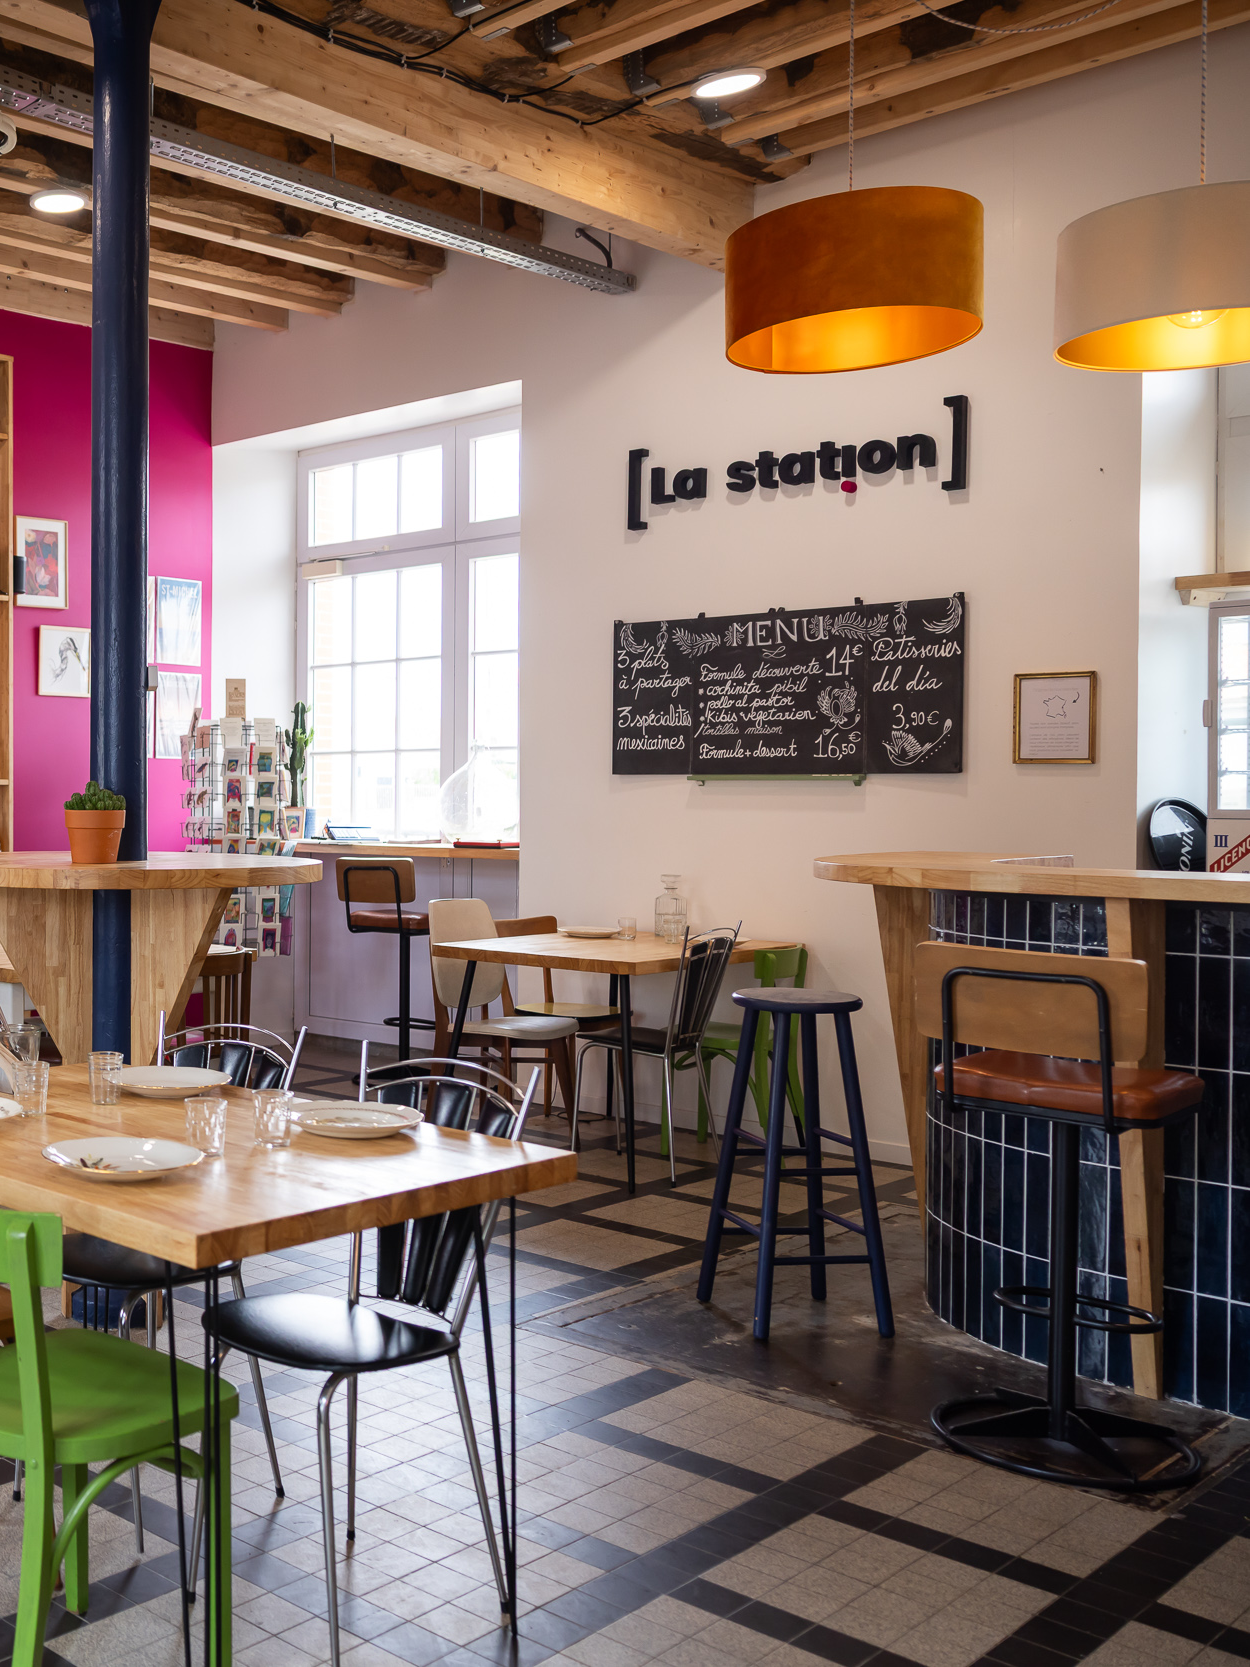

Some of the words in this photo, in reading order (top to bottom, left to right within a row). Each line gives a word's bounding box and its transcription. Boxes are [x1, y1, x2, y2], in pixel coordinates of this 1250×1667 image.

[731, 616, 829, 647] MENU
[617, 650, 630, 668] 3
[631, 643, 669, 680] plats
[700, 663, 746, 681] Formule
[752, 657, 823, 679] découverte
[619, 674, 629, 689] à
[631, 670, 692, 700] partager
[706, 679, 761, 696] cochinita
[766, 676, 808, 699] pibil
[873, 665, 898, 692] del
[906, 664, 942, 690] día
[705, 696, 734, 717] pollo
[735, 695, 748, 707] al
[749, 695, 795, 712] pastor
[706, 709, 737, 723] Kibis
[617, 706, 632, 728] 3
[631, 703, 692, 735] spécialités
[745, 724, 783, 735] maison
[617, 735, 685, 750] mexicaines
[699, 738, 744, 759] Formule
[753, 739, 797, 757] dessert
[1178, 820, 1195, 872] ONIN
[1213, 834, 1229, 848] III
